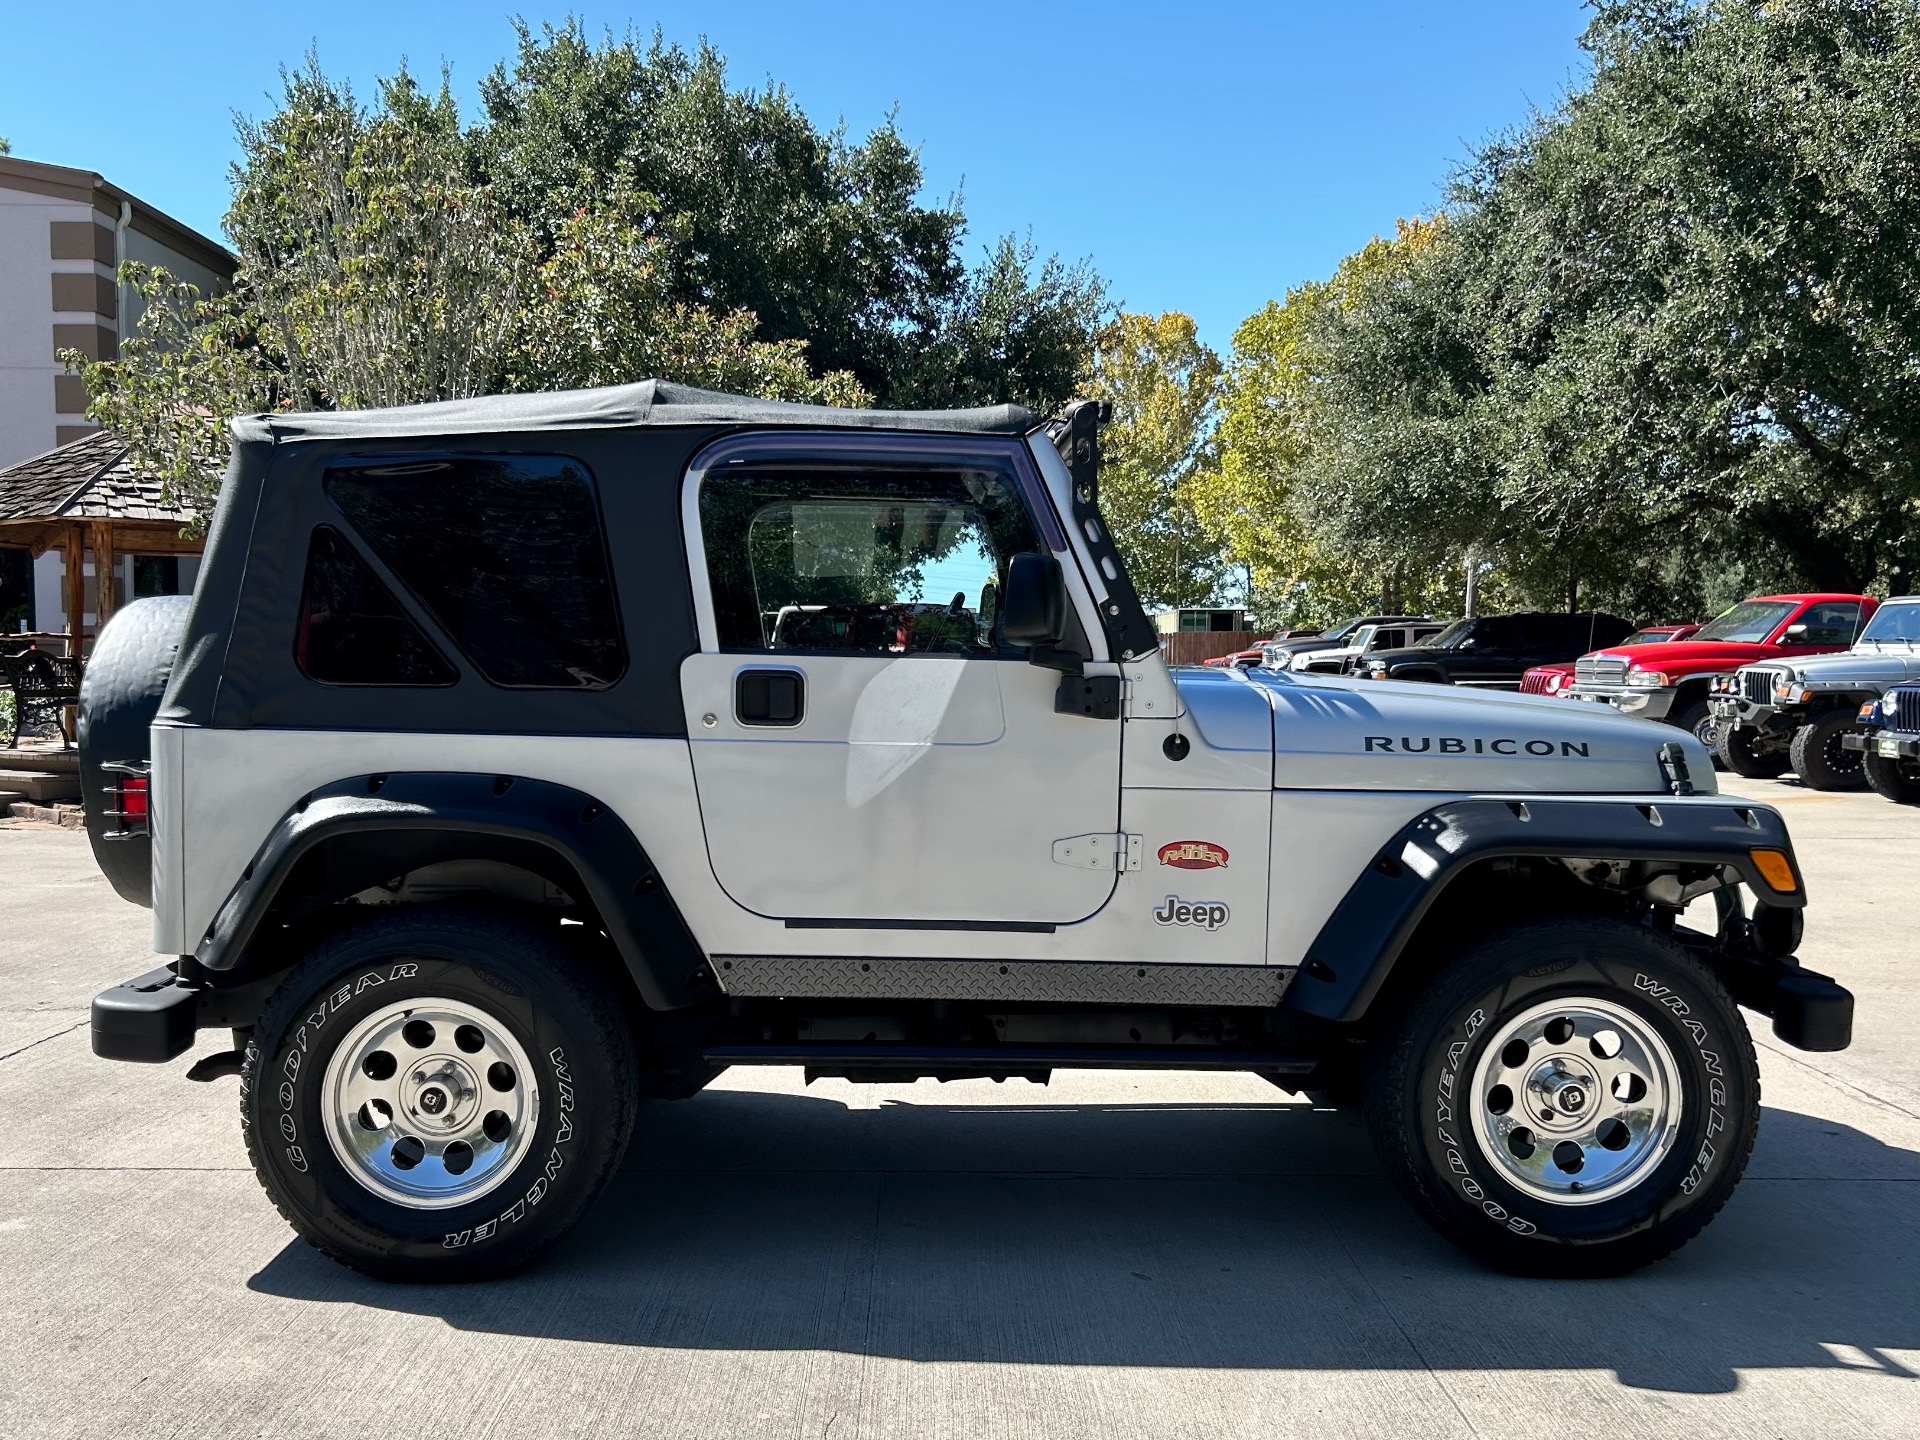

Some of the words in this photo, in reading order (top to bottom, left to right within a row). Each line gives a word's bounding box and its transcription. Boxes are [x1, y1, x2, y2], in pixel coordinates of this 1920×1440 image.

[1363, 735, 1590, 759] RUBICON
[1155, 898, 1227, 929] Jeep
[1160, 849, 1229, 869] RAIDER
[279, 962, 419, 1173] GOODYEAR
[442, 1045, 576, 1250] WRANGLER
[1436, 1007, 1537, 1236] GOODYEAR
[1633, 971, 1727, 1196] WRANGLER
